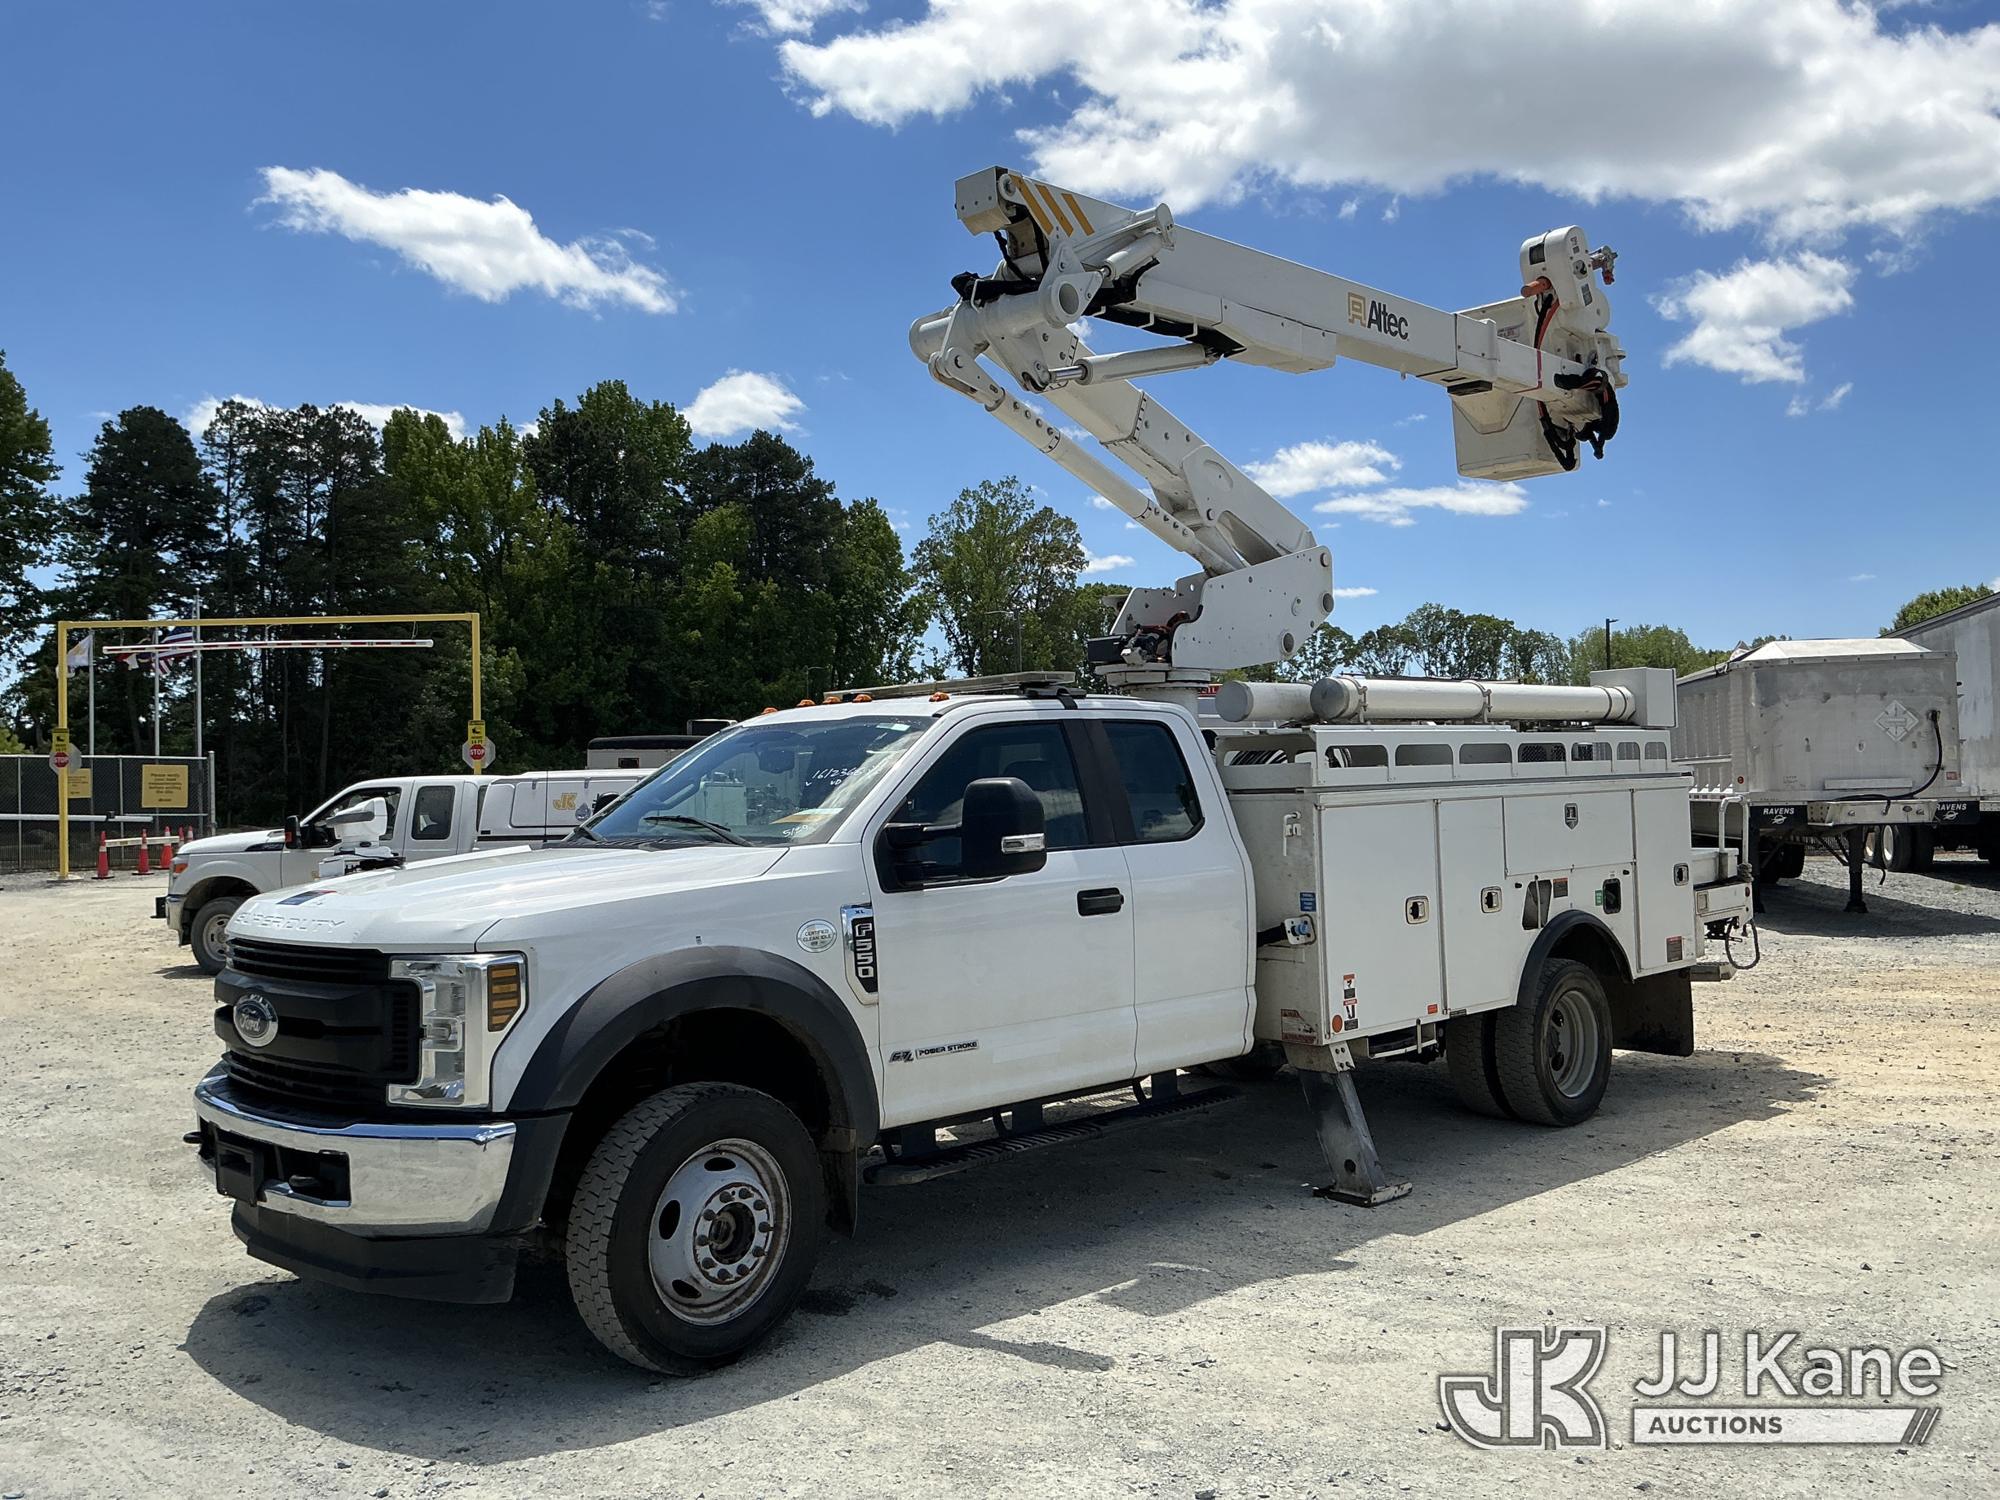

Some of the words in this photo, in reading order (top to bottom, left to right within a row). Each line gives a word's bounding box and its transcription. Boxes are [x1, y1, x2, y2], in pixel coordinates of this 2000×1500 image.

[1367, 300, 1408, 340] Altec
[1763, 807, 1795, 815] RAVENS
[1936, 803, 1967, 811] RAVENS
[855, 922, 875, 979] F550
[919, 1046, 946, 1056] POWER
[947, 1041, 978, 1051] STROKE
